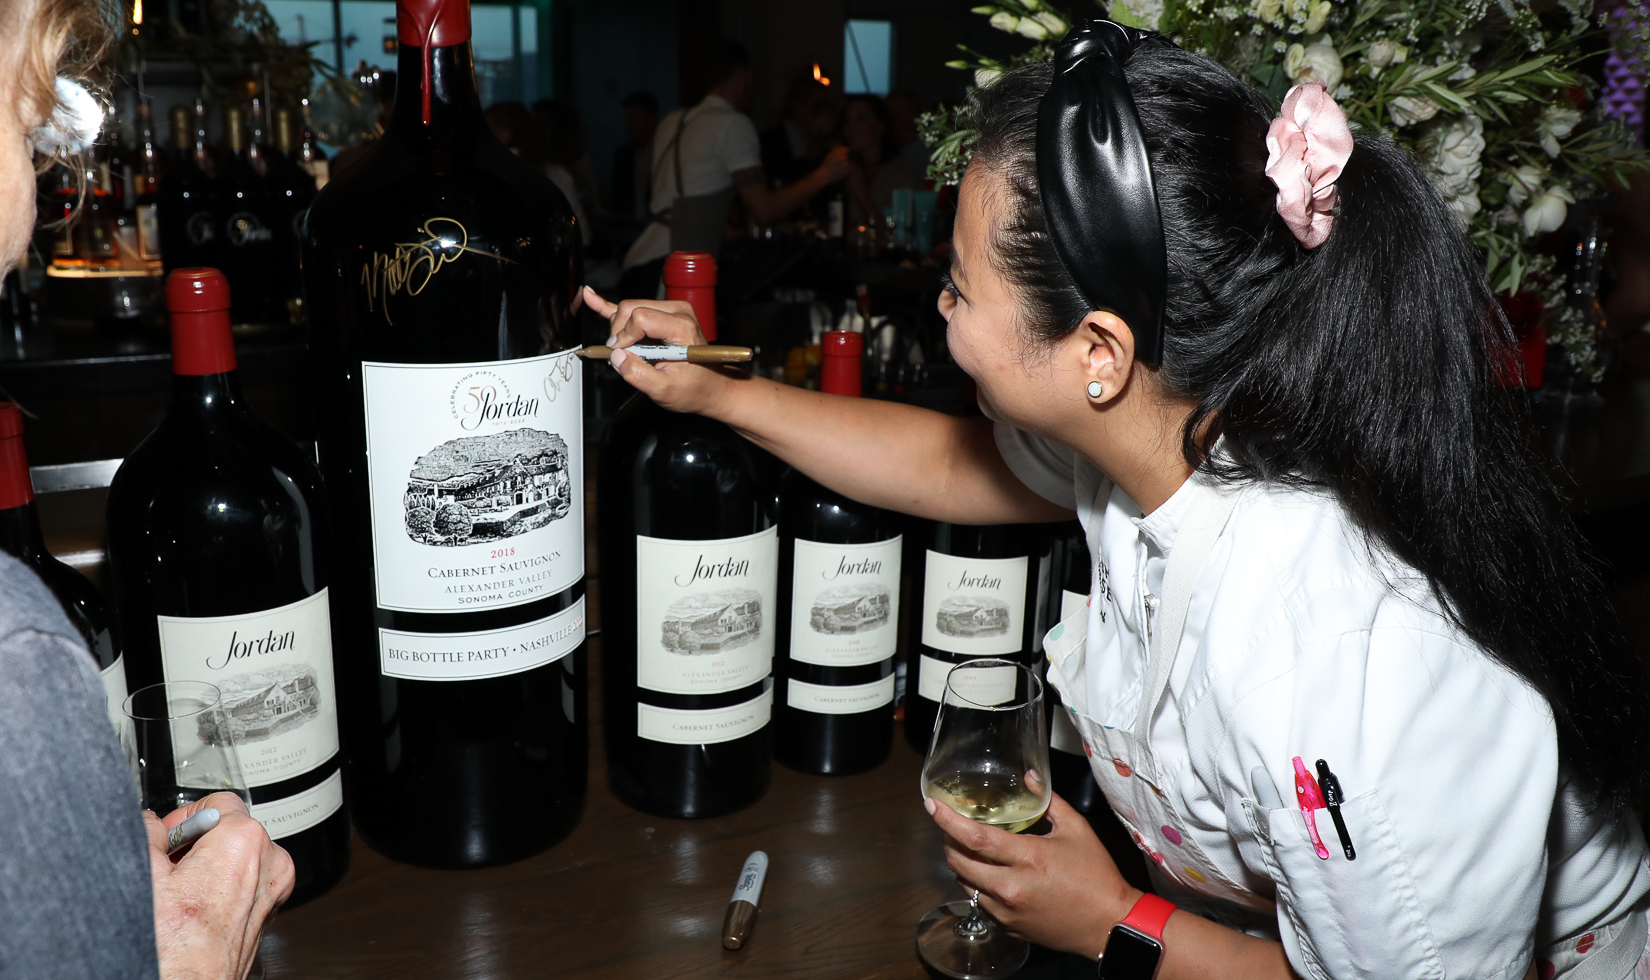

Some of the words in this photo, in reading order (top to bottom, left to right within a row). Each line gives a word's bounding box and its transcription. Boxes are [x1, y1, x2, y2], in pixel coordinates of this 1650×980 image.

[449, 373, 473, 419] CELEBRATING
[475, 370, 497, 378] FIFTY
[497, 376, 511, 399] YEARS
[463, 385, 497, 414] 50
[460, 392, 539, 431] Jordan
[427, 565, 497, 579] CABERNET
[499, 549, 562, 574] SAUVIGNON
[490, 547, 516, 559] 2018
[674, 554, 750, 588] Jordan
[821, 555, 882, 580] Jordan
[444, 579, 515, 594] ALEXANDER
[518, 569, 552, 585] VALLEY
[947, 570, 1002, 591] Jordan
[458, 593, 503, 605] SONOMA
[508, 584, 544, 598] COUNTY
[206, 630, 295, 671] Jordan
[388, 648, 409, 661] BIG
[412, 651, 464, 663] BOTTLE
[467, 646, 510, 663] PARTY
[519, 623, 572, 655] NASHVILLE
[682, 670, 725, 678] ALEXANDER
[672, 723, 714, 732] CABERNET
[715, 715, 755, 730] SAUVIGNON
[260, 746, 277, 756] 2012
[281, 747, 308, 761] VALLEY
[273, 759, 301, 771] COUNTY
[271, 802, 320, 826] SAUVIGNON
